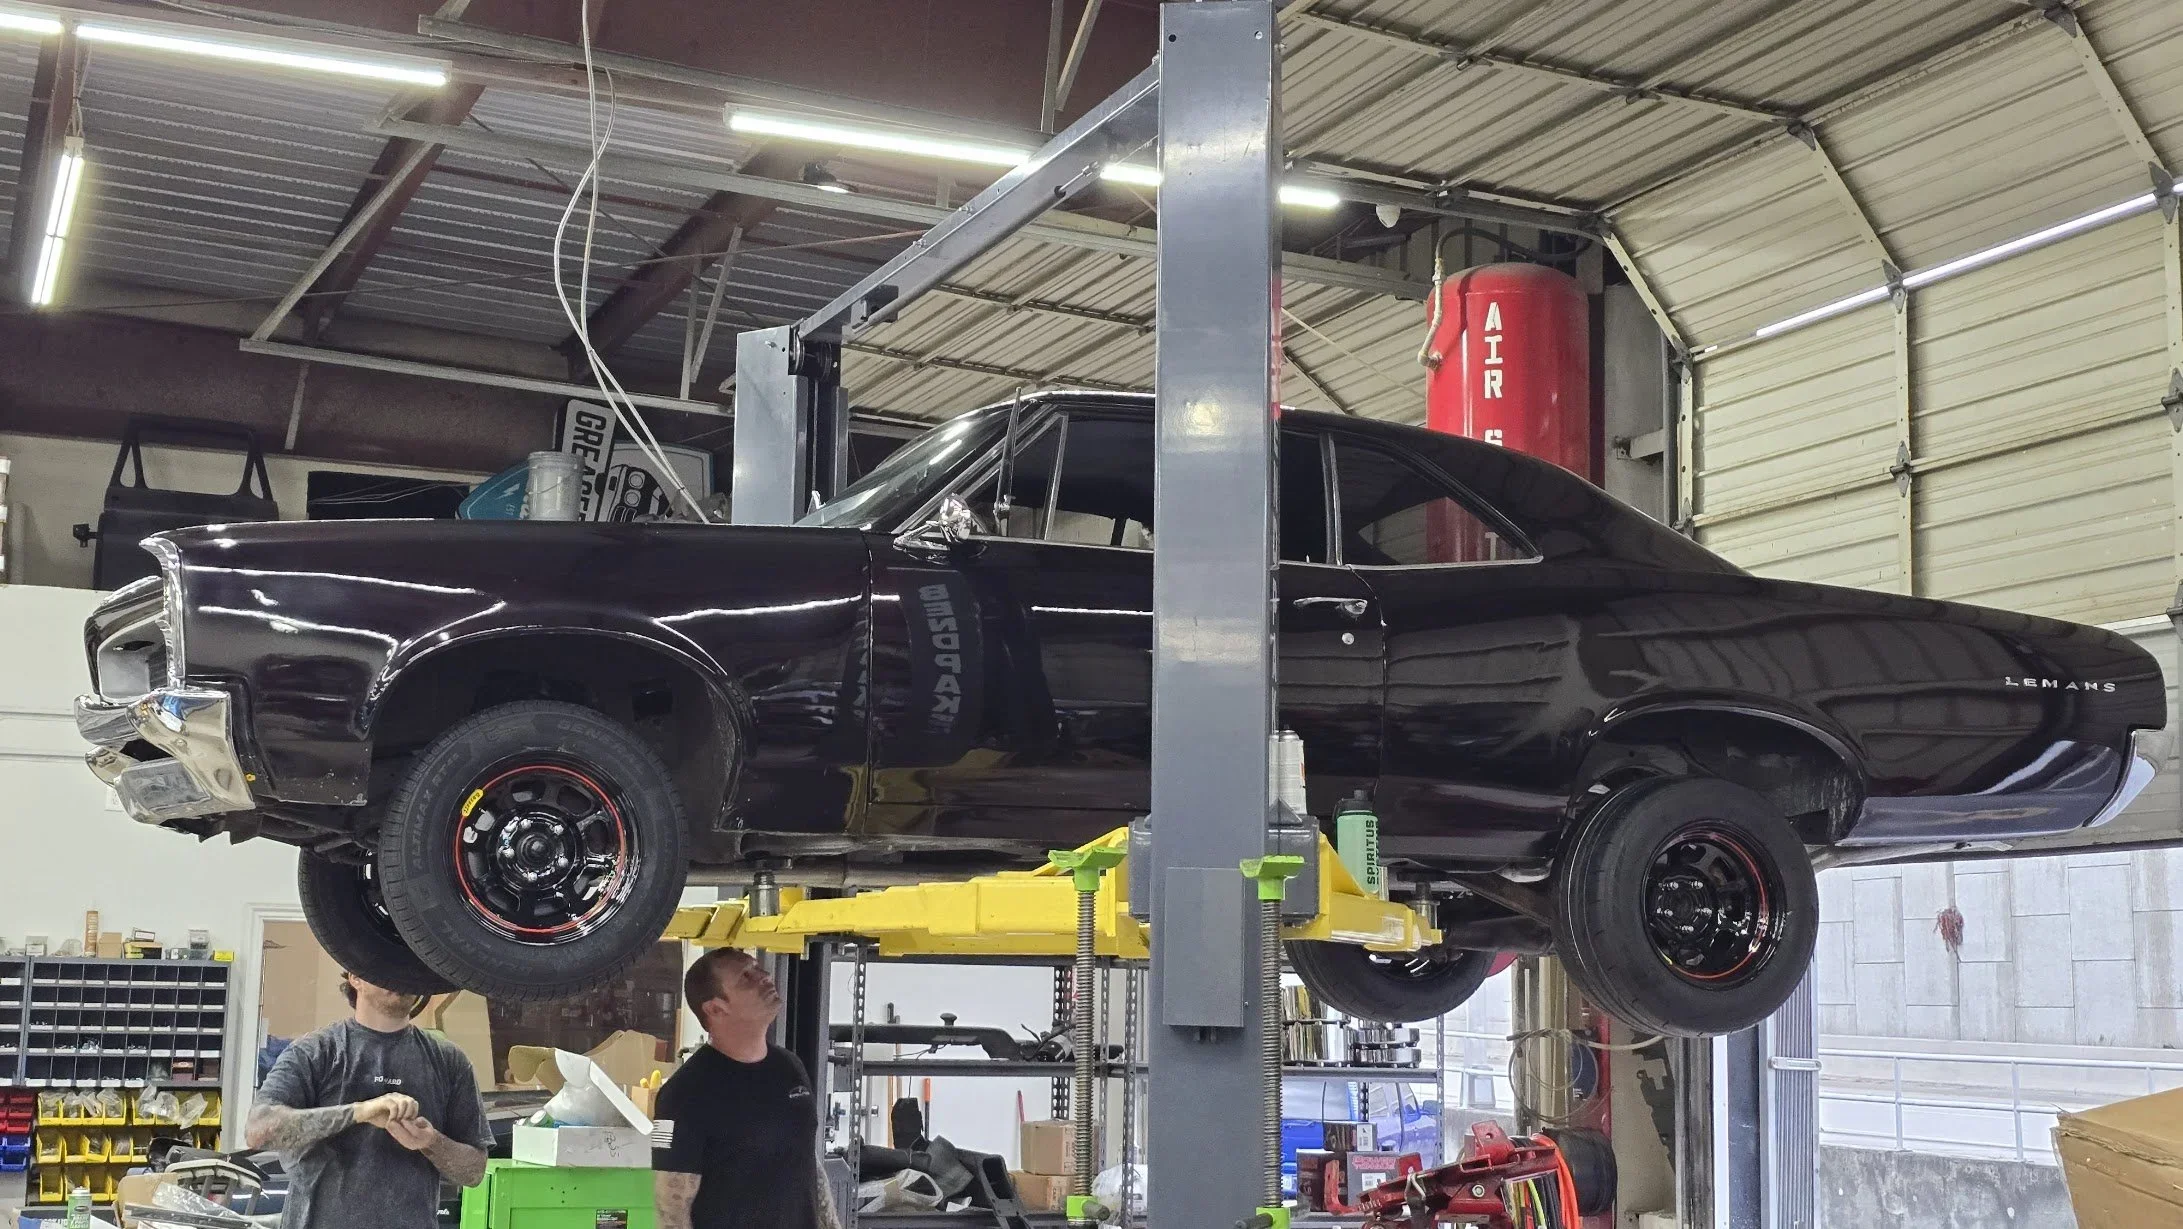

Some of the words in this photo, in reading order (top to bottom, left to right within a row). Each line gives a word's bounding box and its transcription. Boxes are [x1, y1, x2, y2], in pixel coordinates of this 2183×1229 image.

[1484, 301, 1503, 399] AIR
[2004, 676, 2117, 693] LEMANS
[1365, 819, 1376, 885] SPIRITUS
